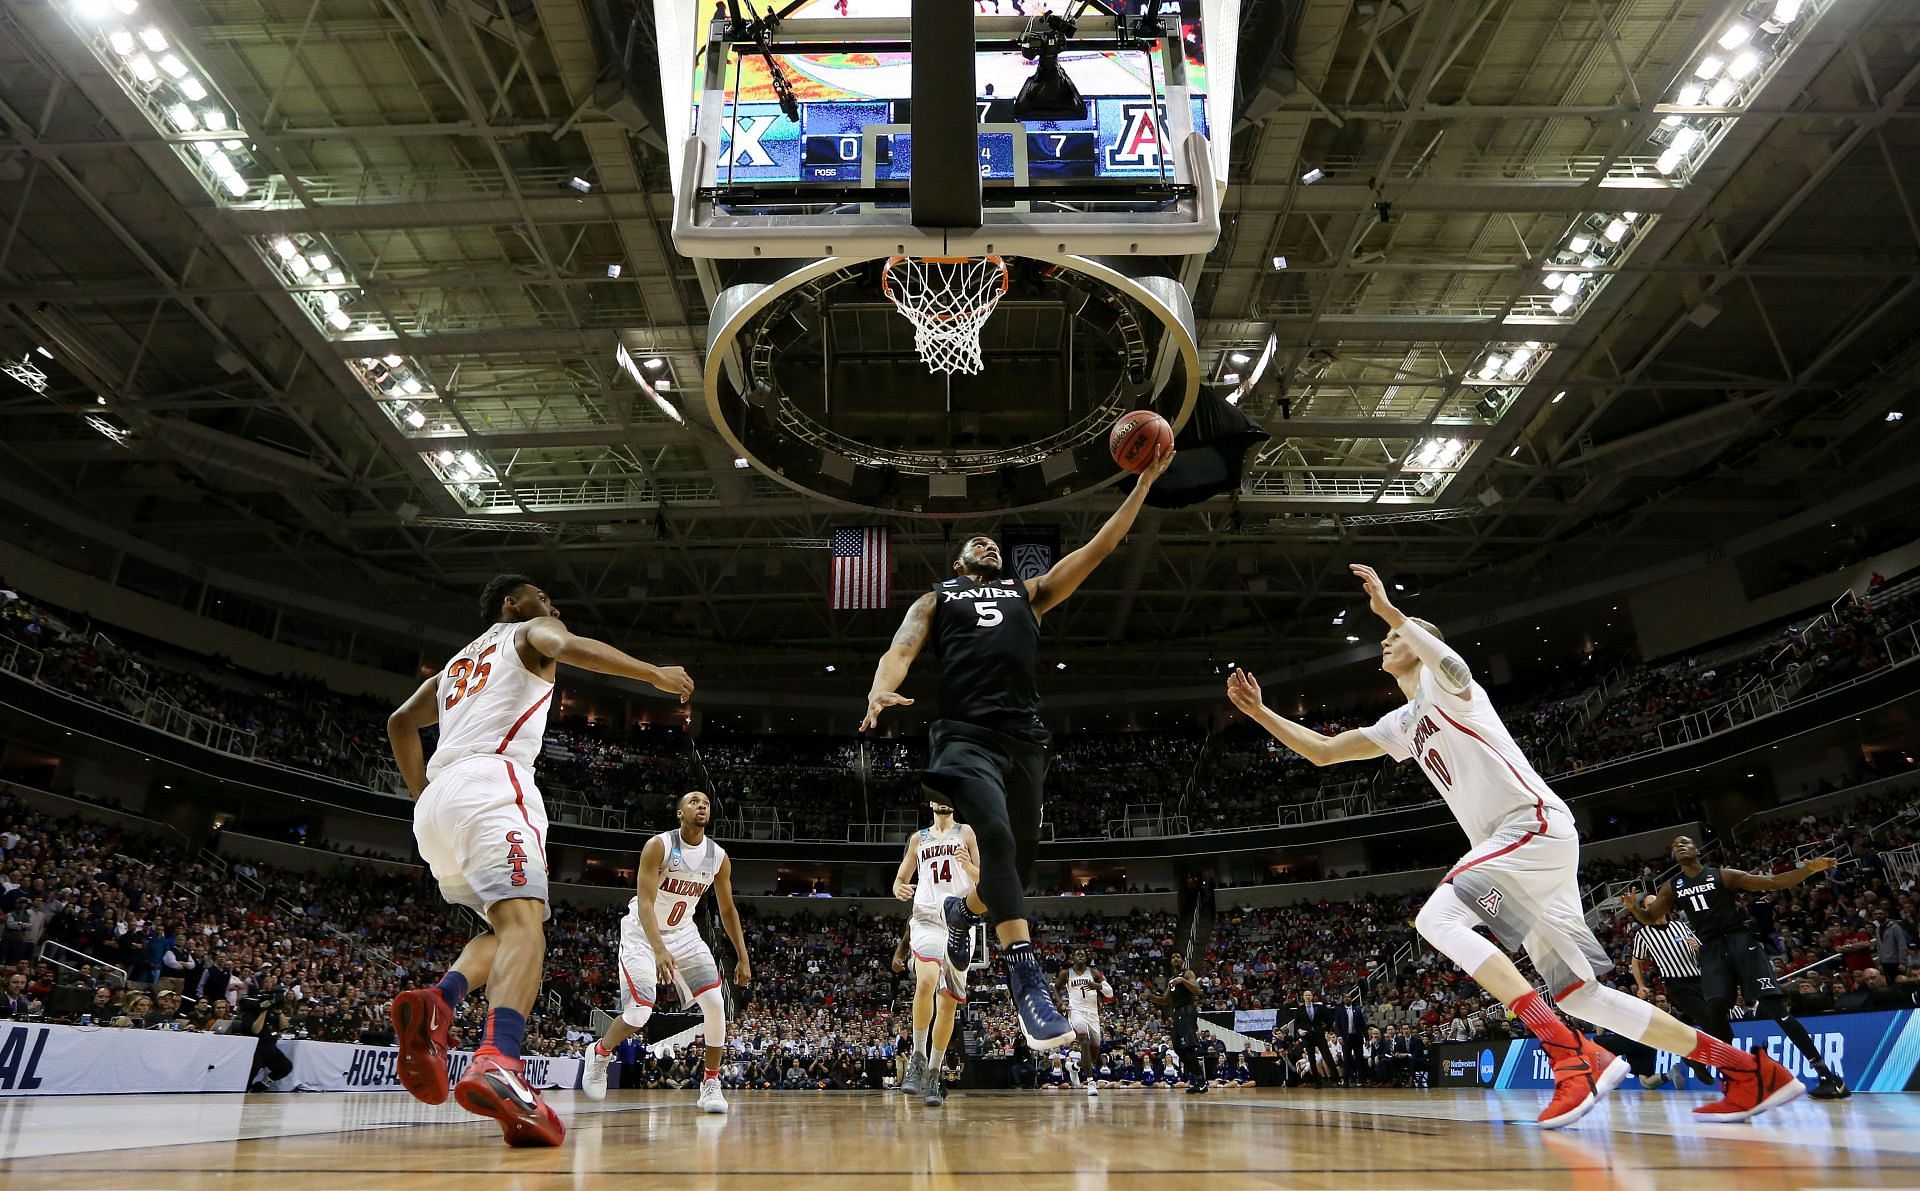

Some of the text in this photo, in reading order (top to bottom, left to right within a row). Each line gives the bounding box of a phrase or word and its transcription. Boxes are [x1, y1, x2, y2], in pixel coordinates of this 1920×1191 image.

[839, 137, 858, 161] 0
[1050, 134, 1067, 158] 7
[941, 587, 1022, 603] XAVIER
[974, 601, 1004, 628] 5
[445, 644, 498, 711] 35
[1424, 748, 1453, 792] 10
[505, 830, 529, 887] CATS
[930, 859, 953, 885] 14
[1476, 886, 1504, 918] A
[1676, 883, 1717, 899] XAVIER
[1689, 894, 1711, 912] 11
[666, 901, 688, 927] 0
